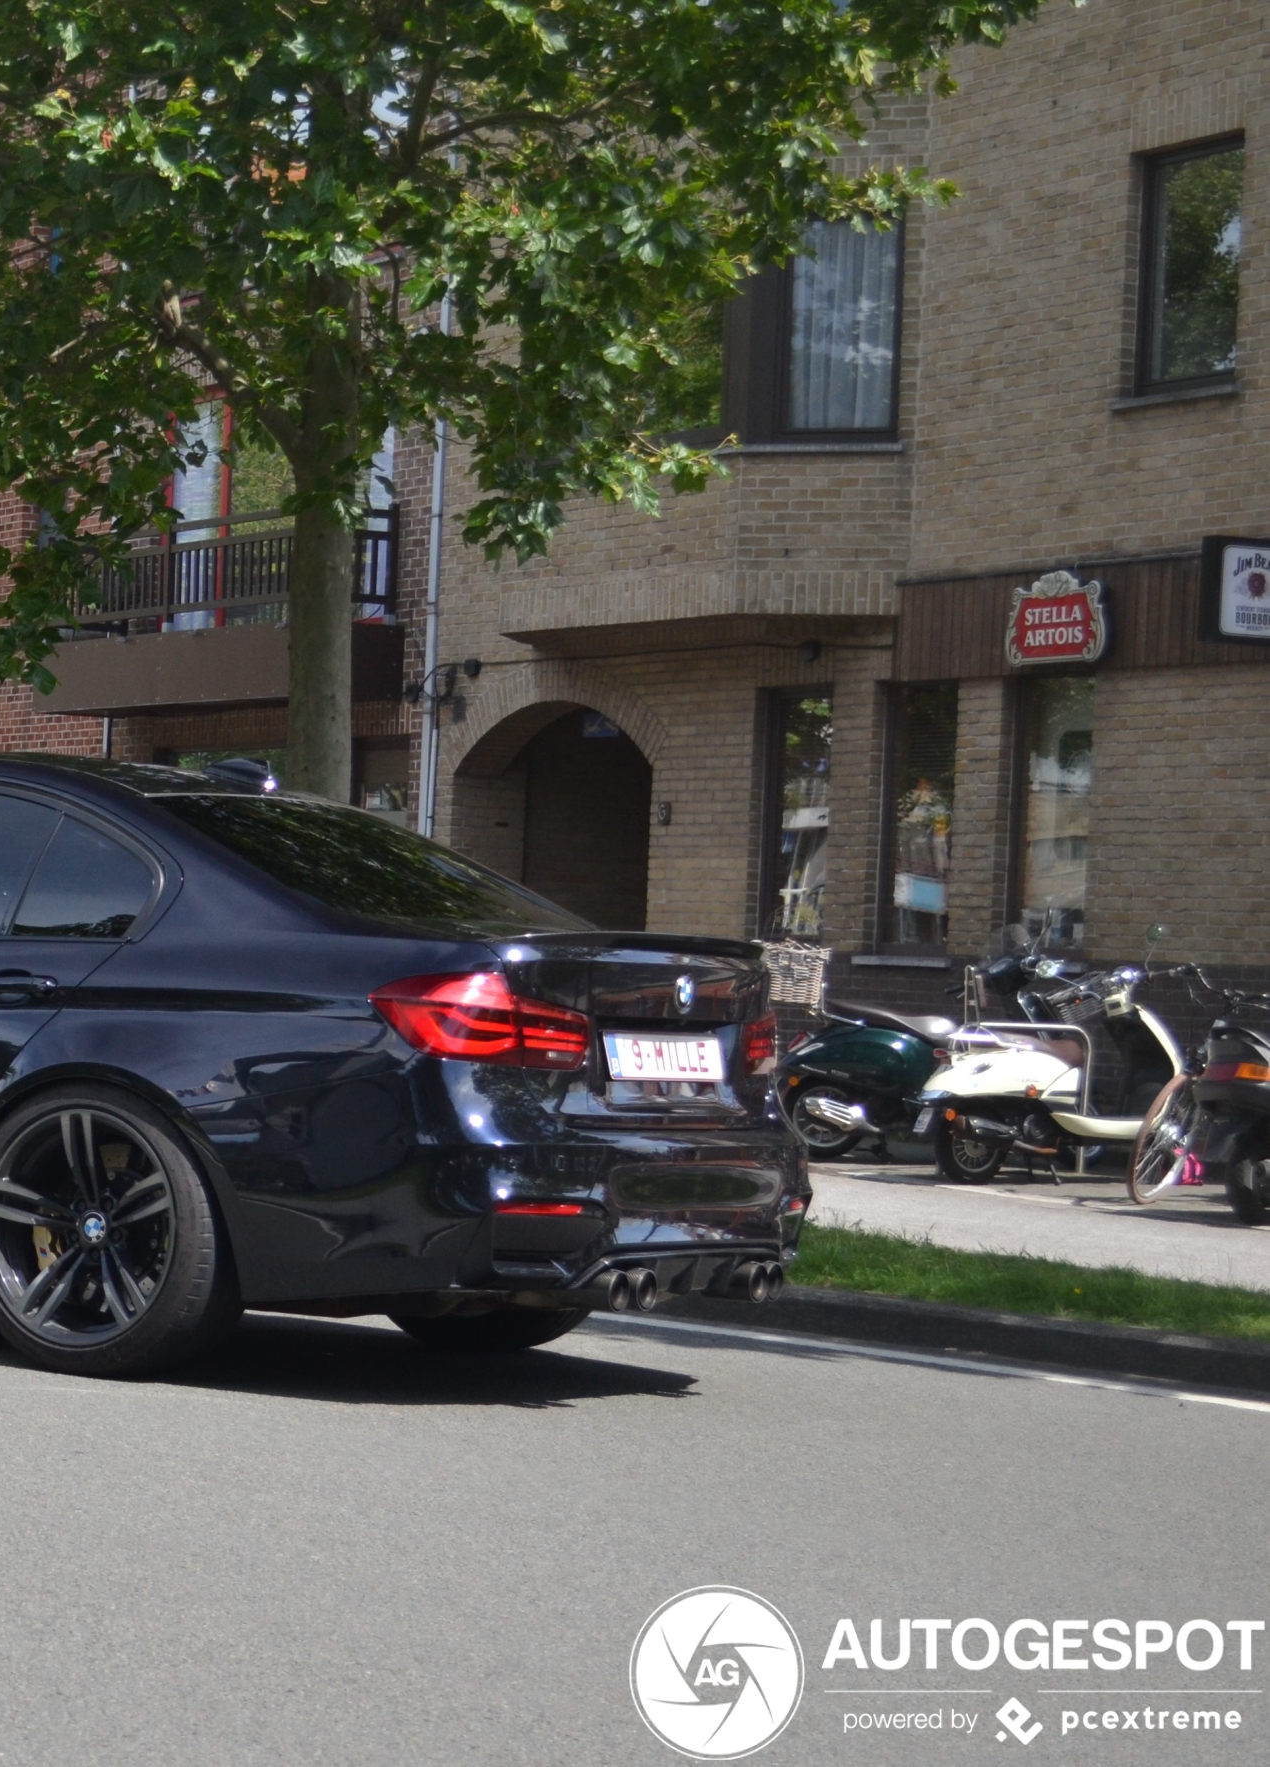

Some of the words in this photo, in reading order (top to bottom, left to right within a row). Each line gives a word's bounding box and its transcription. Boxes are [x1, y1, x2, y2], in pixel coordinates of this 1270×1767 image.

[1233, 556, 1252, 577] JIM
[1024, 605, 1082, 626] STELLA
[1023, 626, 1083, 647] ARTOIS
